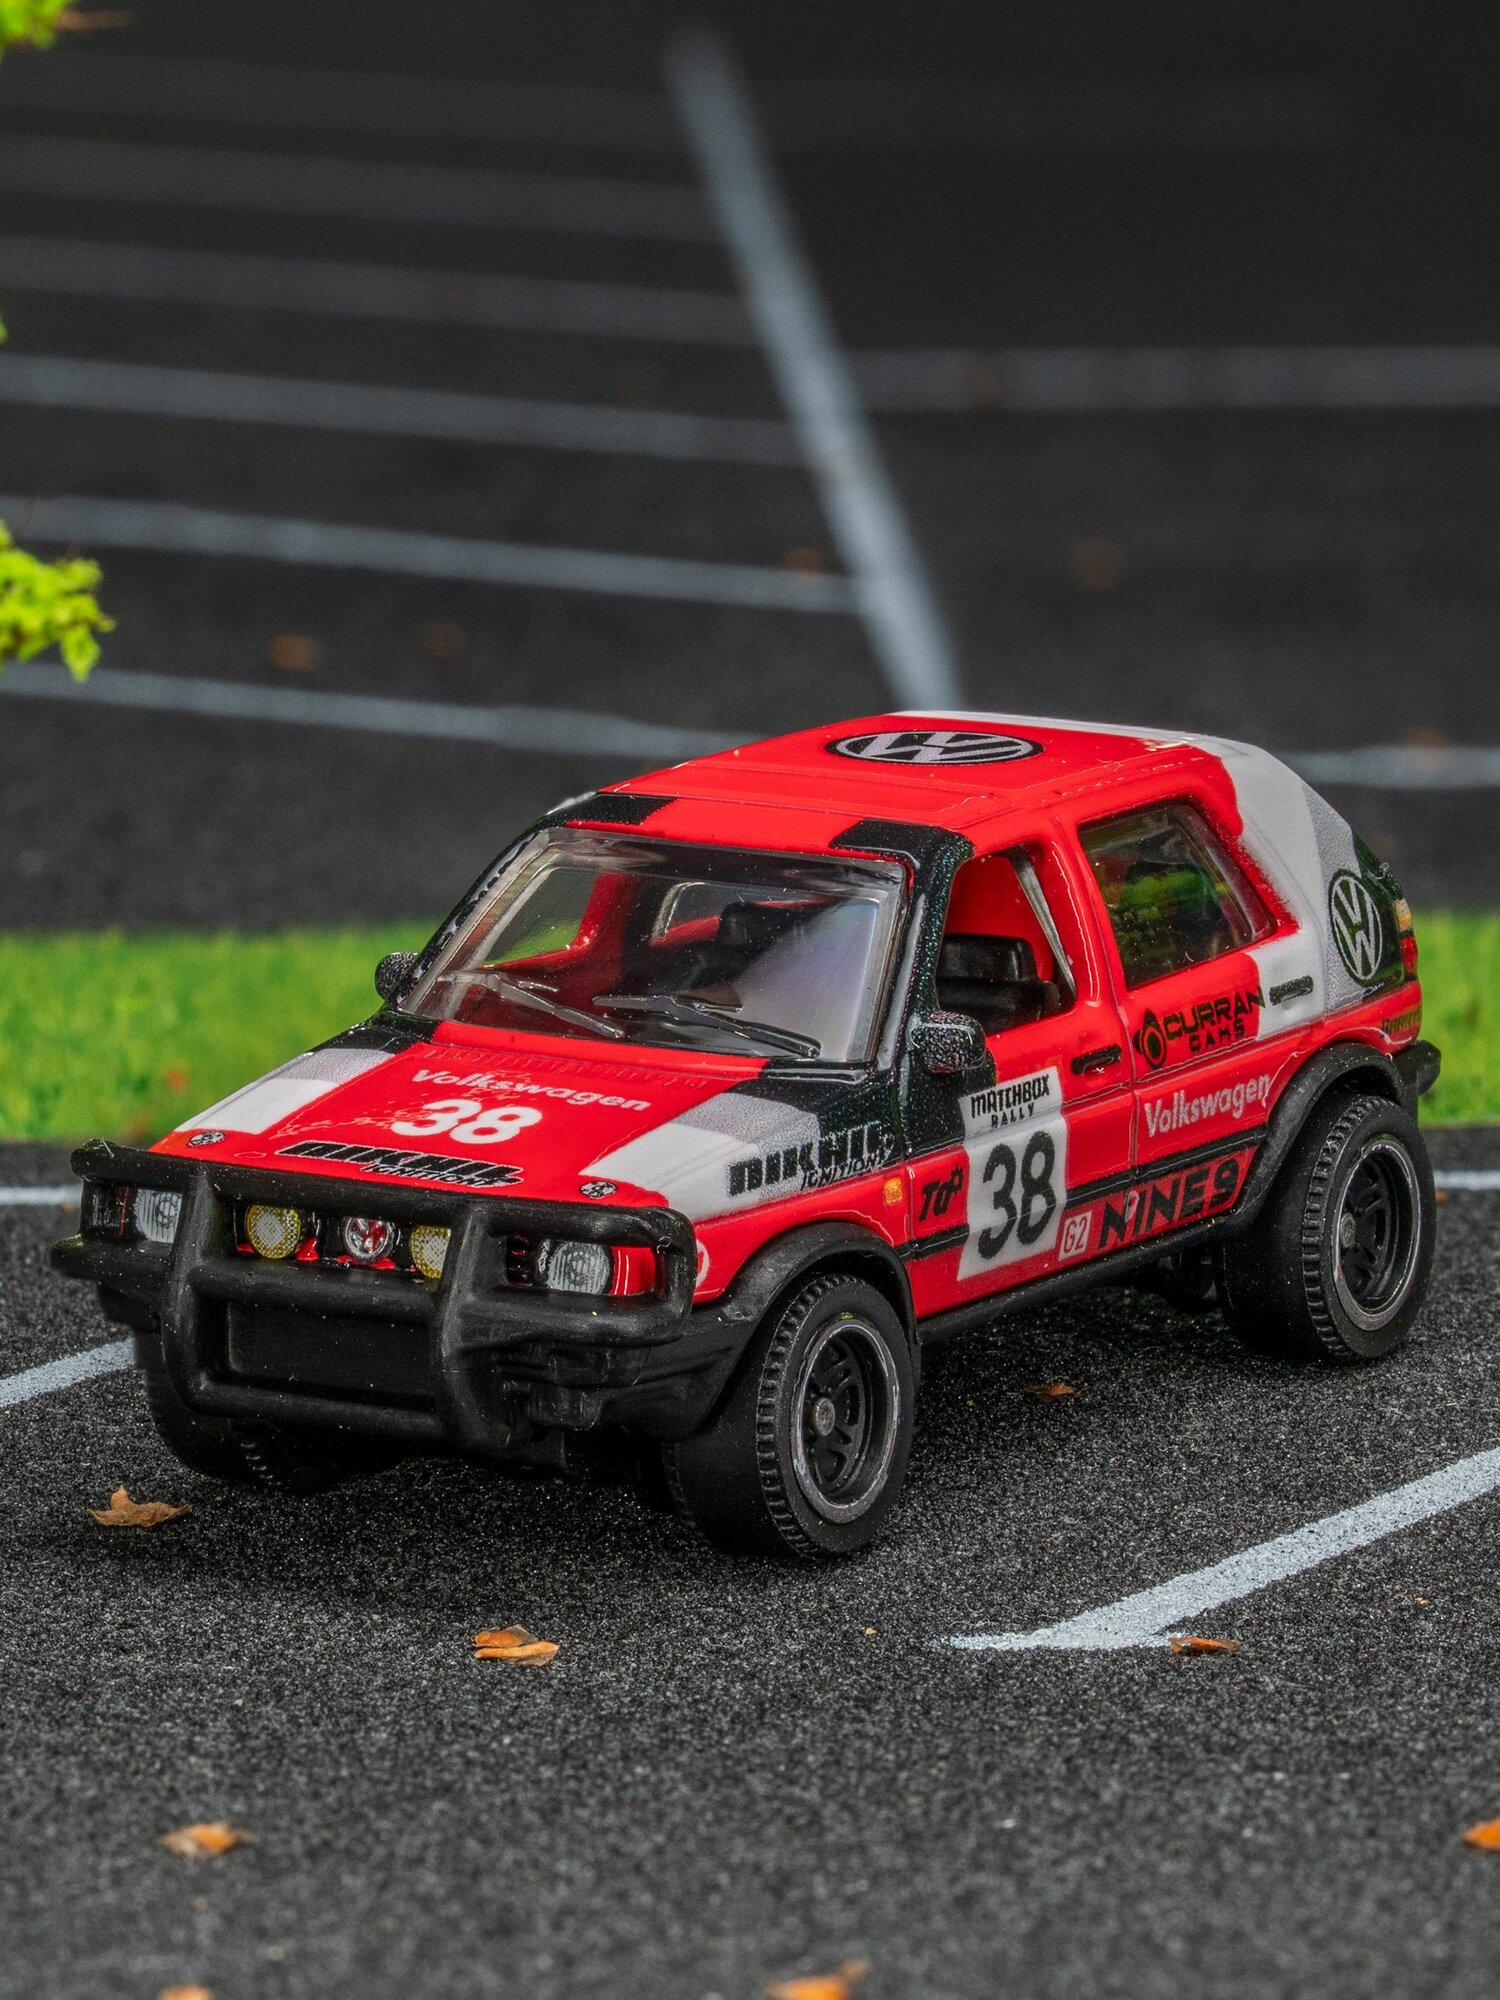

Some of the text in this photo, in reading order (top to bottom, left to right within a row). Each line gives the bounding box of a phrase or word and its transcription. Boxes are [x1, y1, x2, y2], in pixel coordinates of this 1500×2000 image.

[1163, 985, 1266, 1040] CURRAN
[1189, 1017, 1245, 1053] CAMS
[412, 1069, 652, 1111] Volkswagen
[970, 1074, 1050, 1119] MATCHBOX
[1144, 1074, 1271, 1138] Volkswagen
[390, 1099, 543, 1144] 38
[991, 1102, 1035, 1129] RALLY
[978, 1131, 1057, 1260] 38
